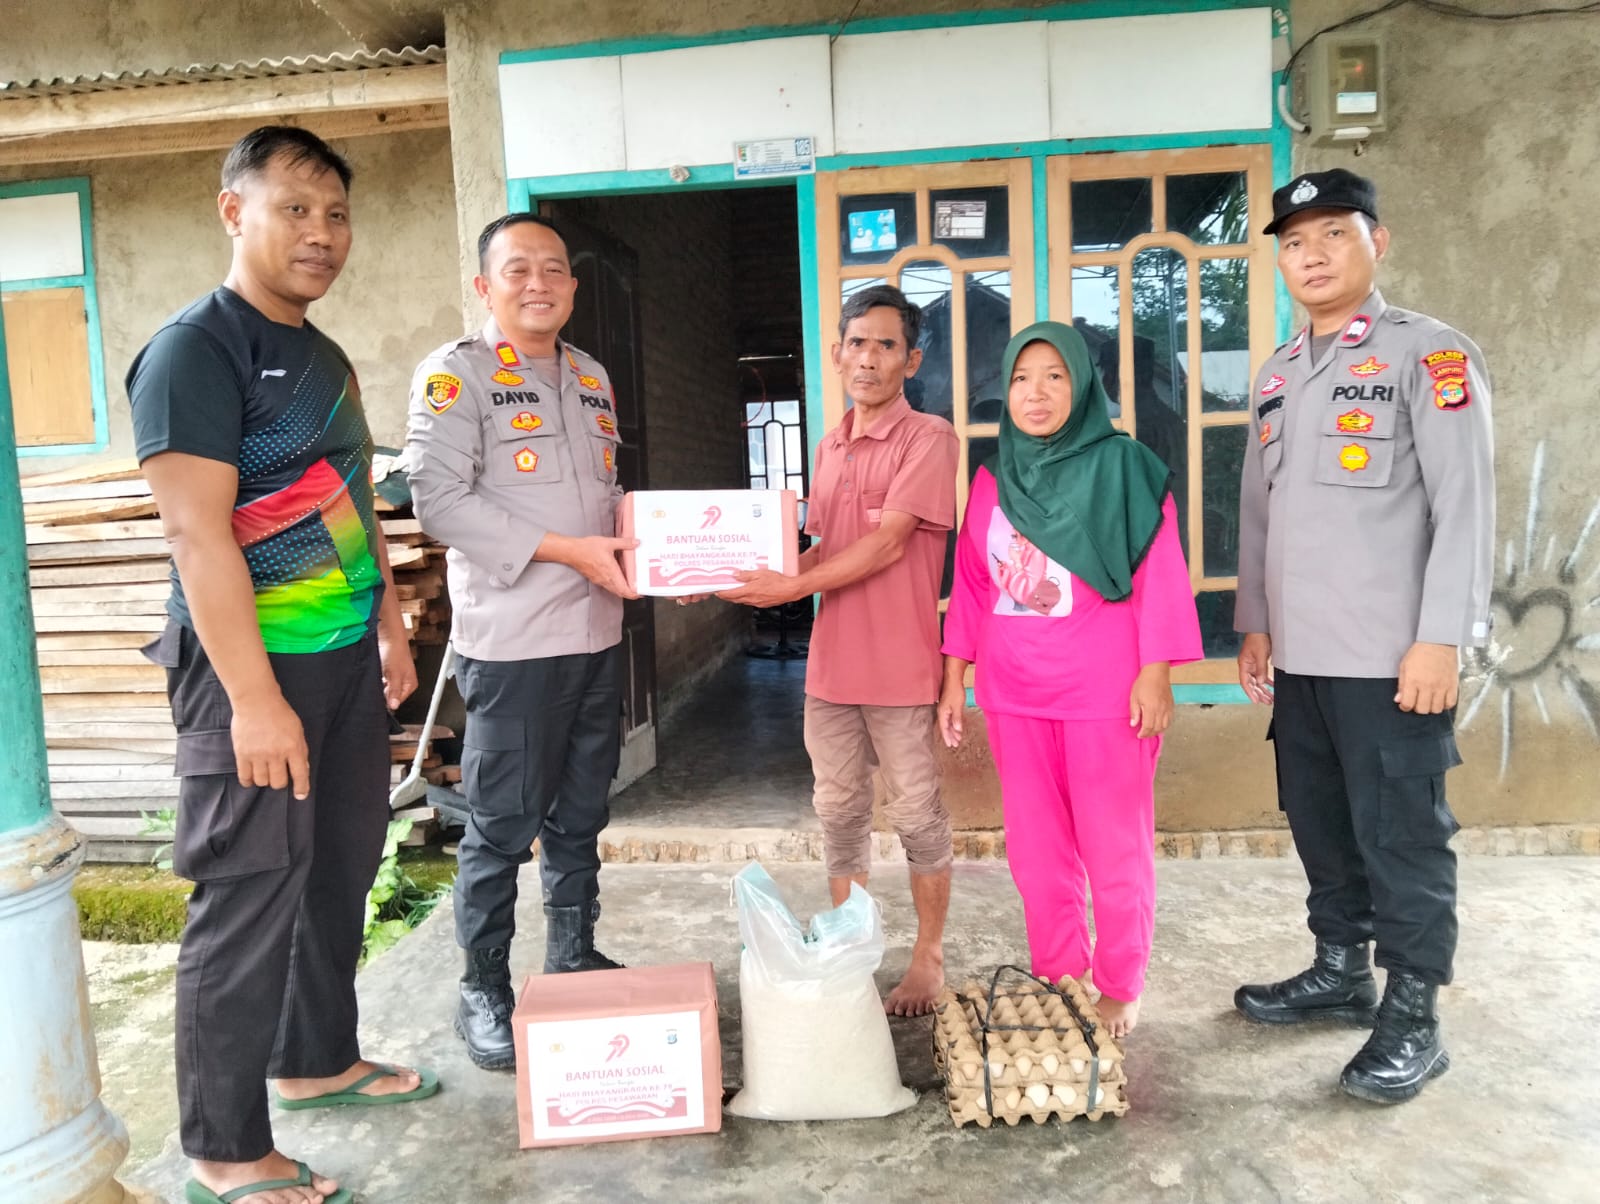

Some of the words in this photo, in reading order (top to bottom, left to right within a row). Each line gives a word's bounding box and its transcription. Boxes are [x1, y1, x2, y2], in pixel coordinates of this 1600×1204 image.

[491, 391, 541, 406] DAVID
[1332, 385, 1394, 402] POLRI
[667, 535, 716, 544] BANTUAN
[718, 534, 752, 543] SOSIAL
[566, 1068, 623, 1081] BANTUAN
[626, 1064, 664, 1077] SOSIAL
